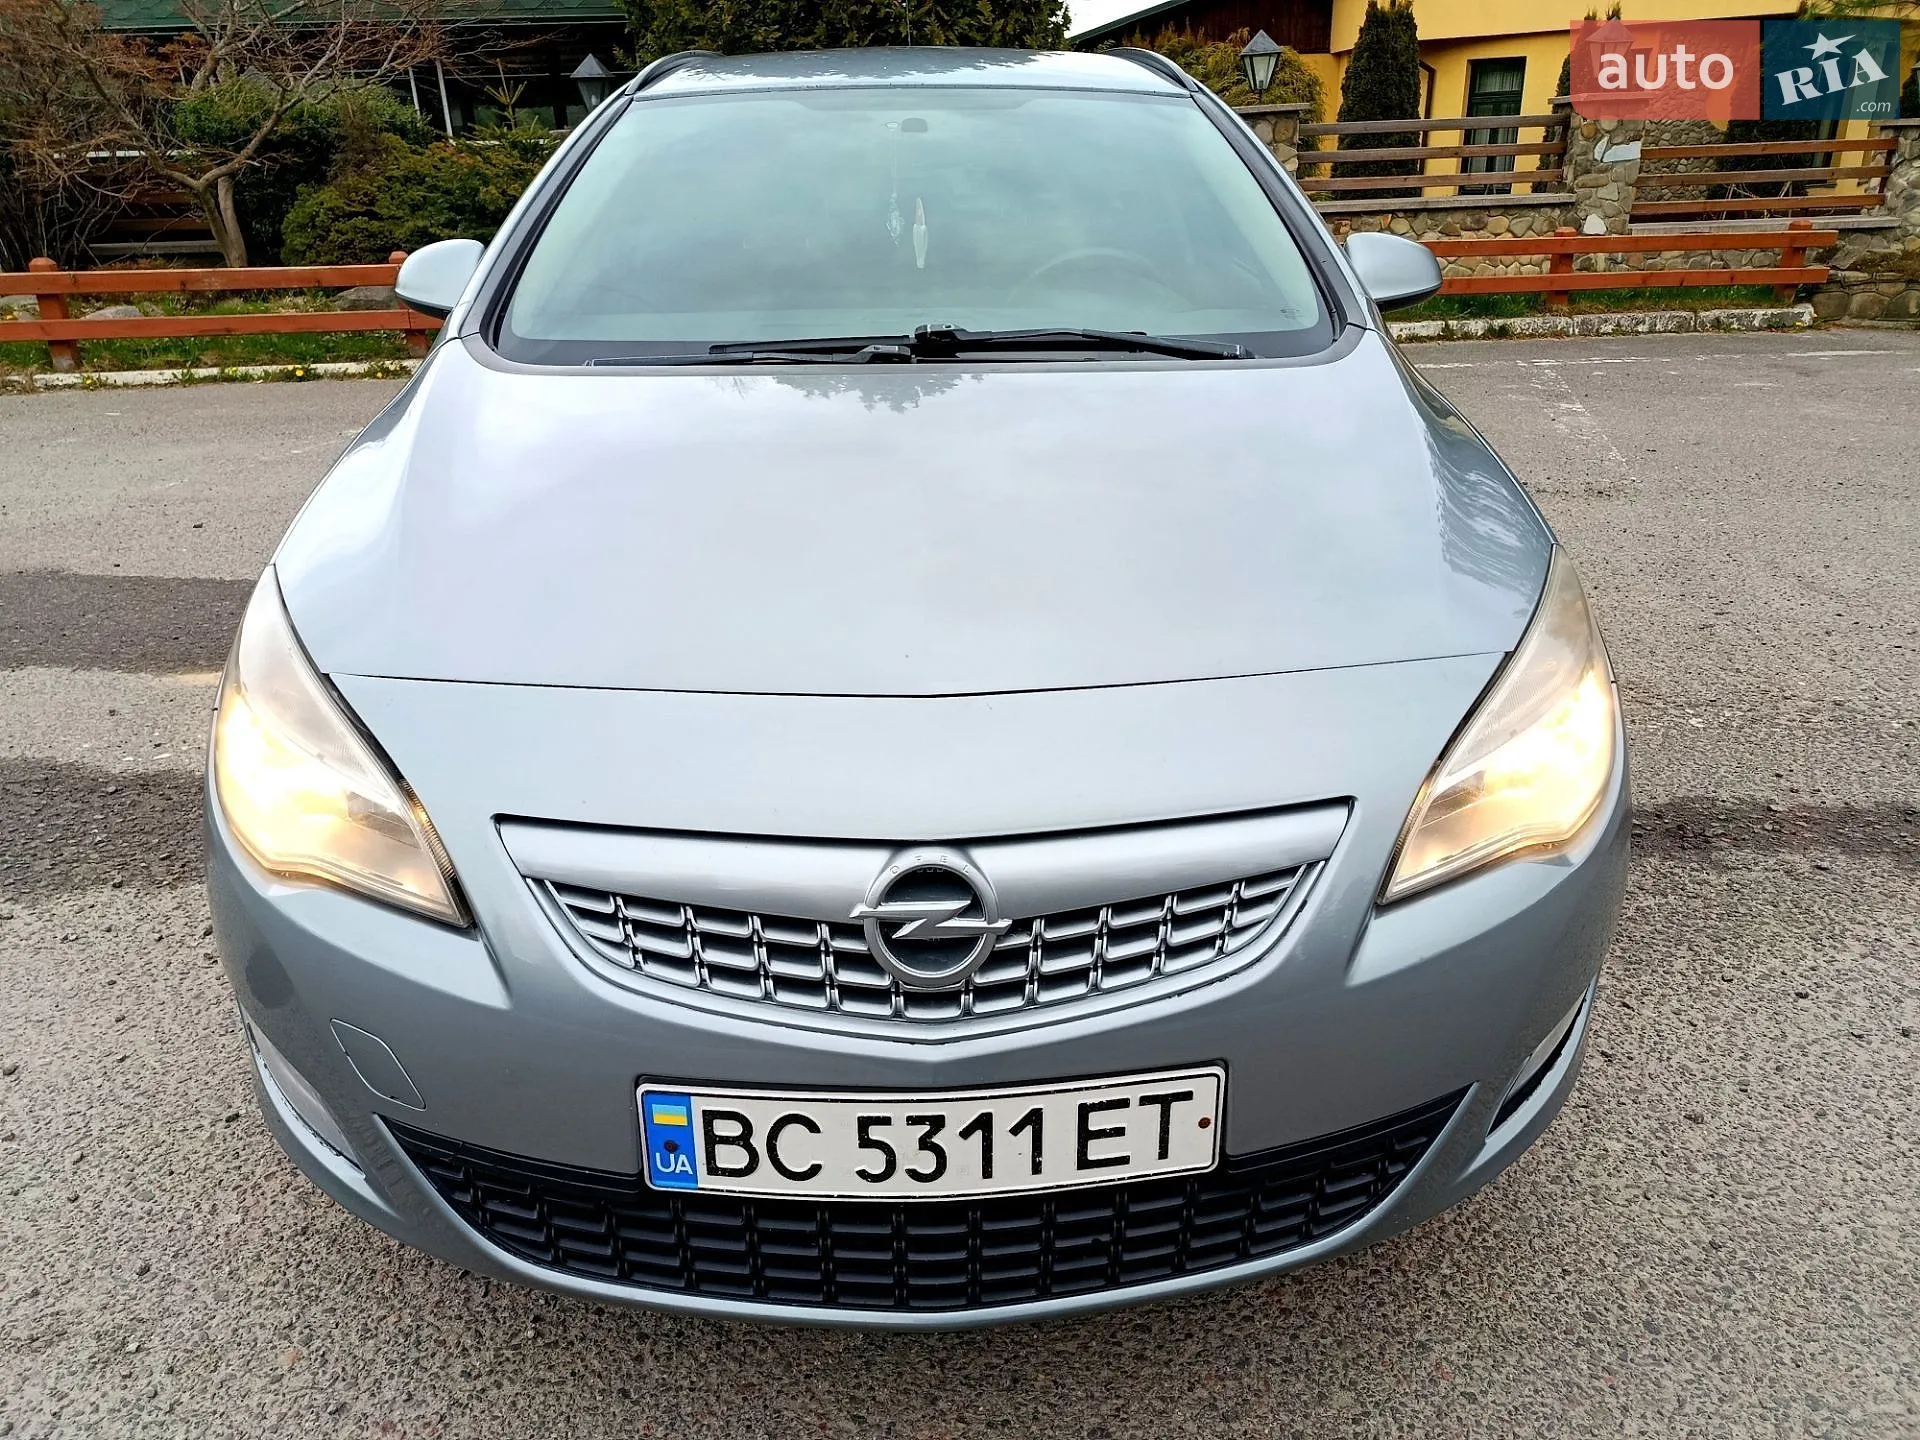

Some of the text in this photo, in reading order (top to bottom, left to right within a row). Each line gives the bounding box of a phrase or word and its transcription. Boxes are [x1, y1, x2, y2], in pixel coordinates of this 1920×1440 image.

[656, 1152, 693, 1175] UA
[701, 1091, 1194, 1183] BC 5311 ET
